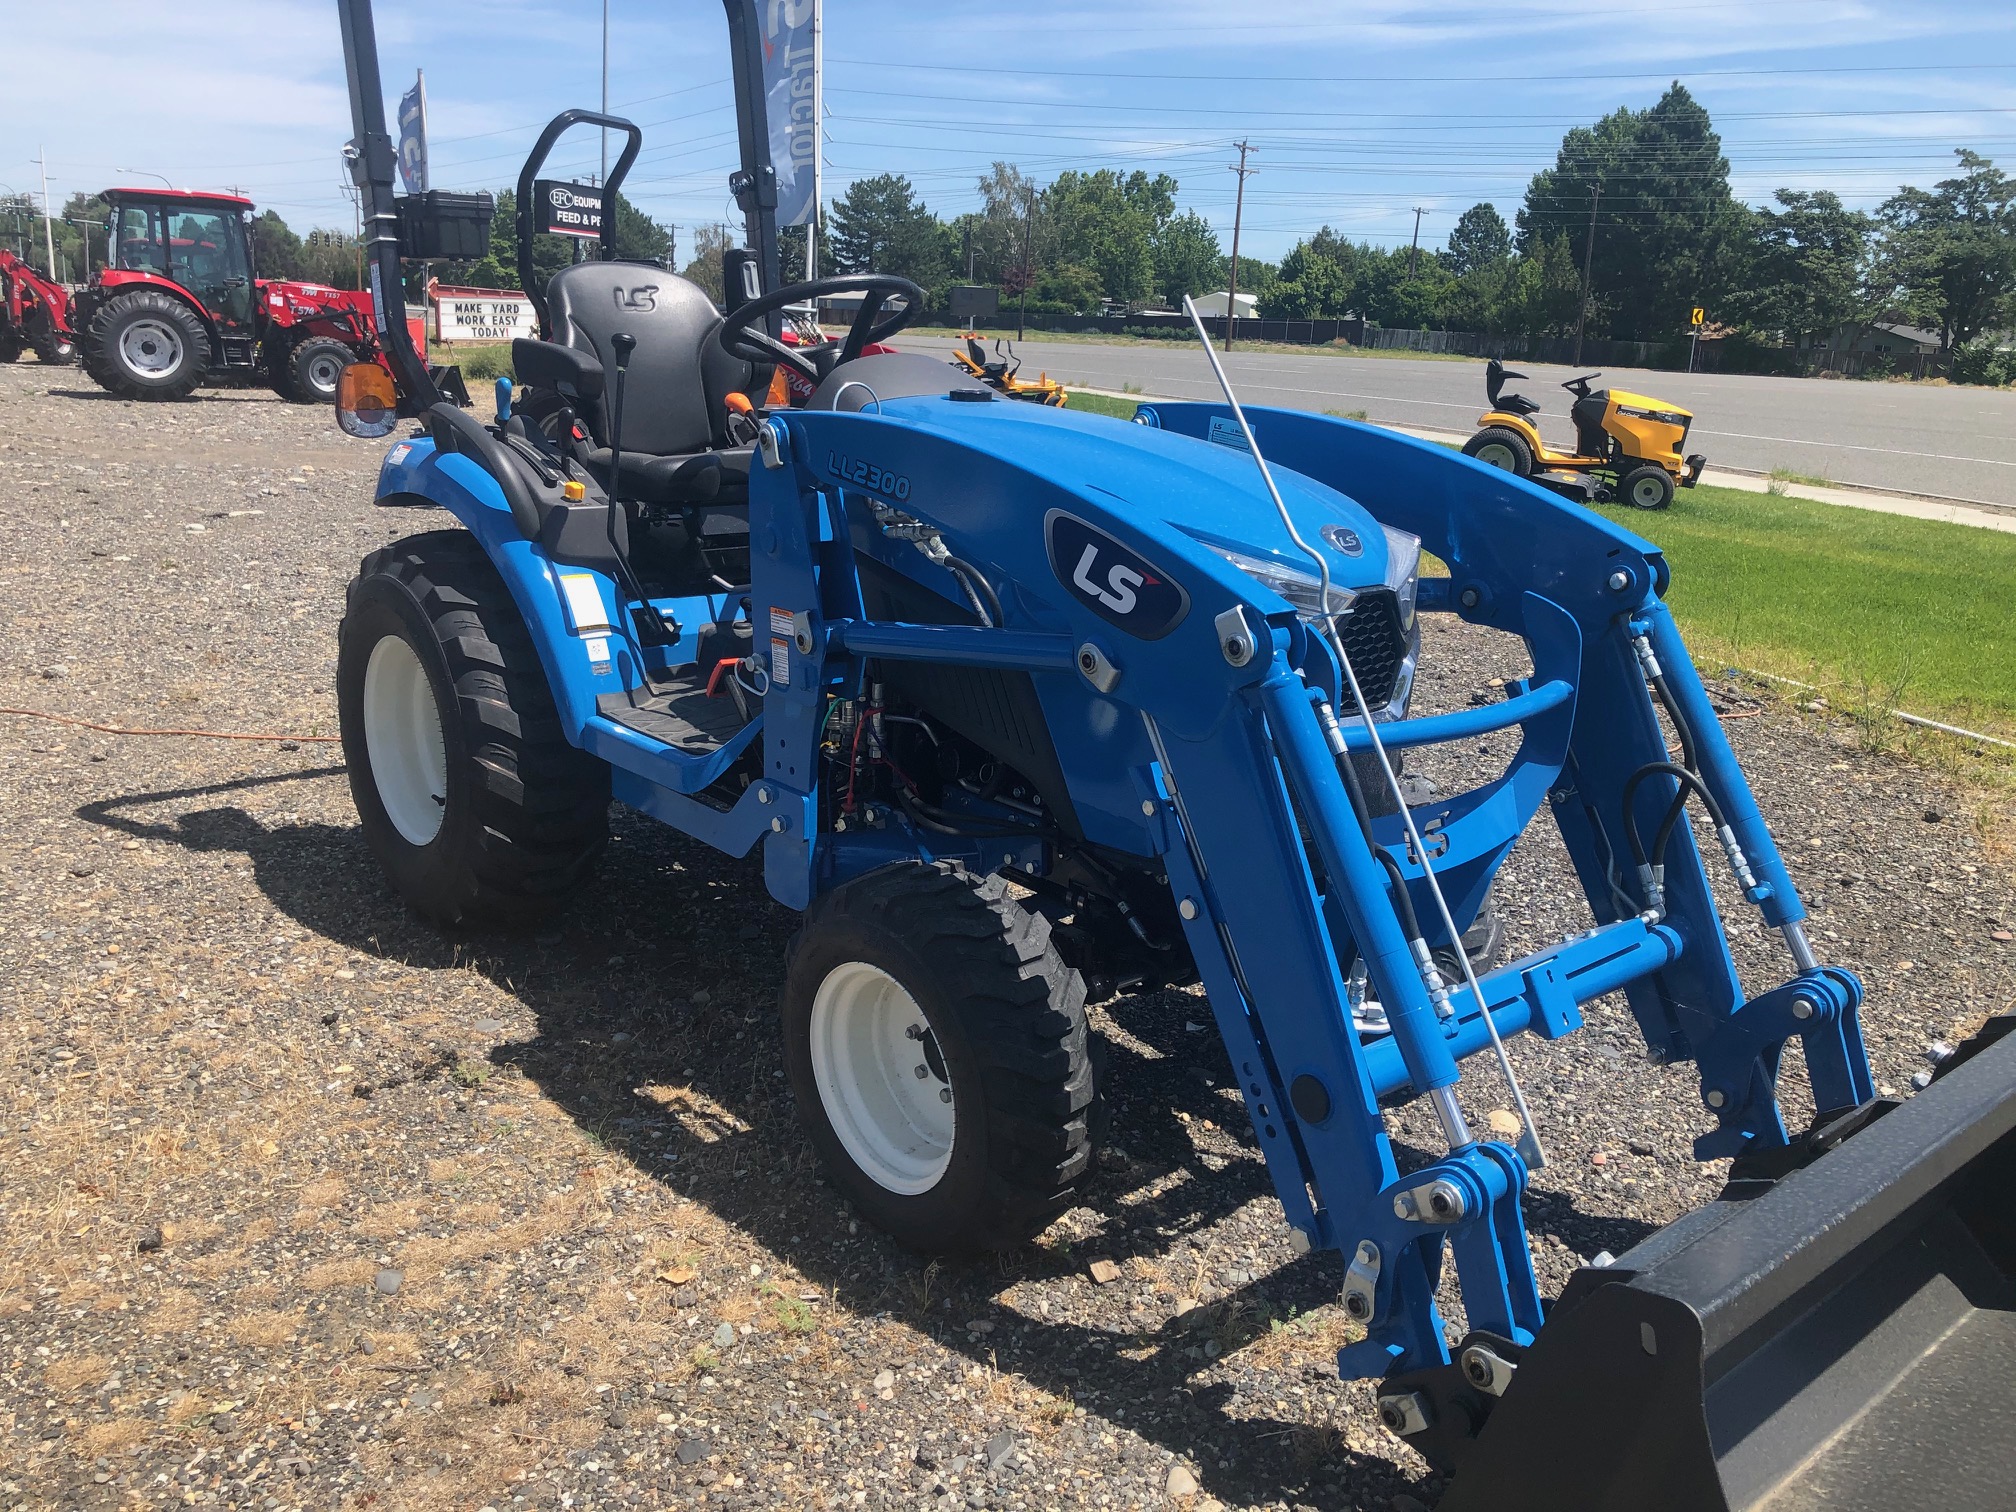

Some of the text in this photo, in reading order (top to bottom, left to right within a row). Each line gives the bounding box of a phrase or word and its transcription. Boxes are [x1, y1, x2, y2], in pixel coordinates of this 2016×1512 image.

[553, 192, 571, 206] EFC
[557, 211, 581, 224] FEED
[582, 214, 589, 226] &
[324, 292, 340, 300] TX57
[613, 285, 659, 312] LS
[455, 304, 520, 314] MAKE YARD
[456, 315, 518, 326] WORK EASY
[471, 327, 509, 337] TODAY!
[828, 450, 911, 500] LL2300
[1339, 536, 1357, 547] LS
[1073, 543, 1144, 614] LS
